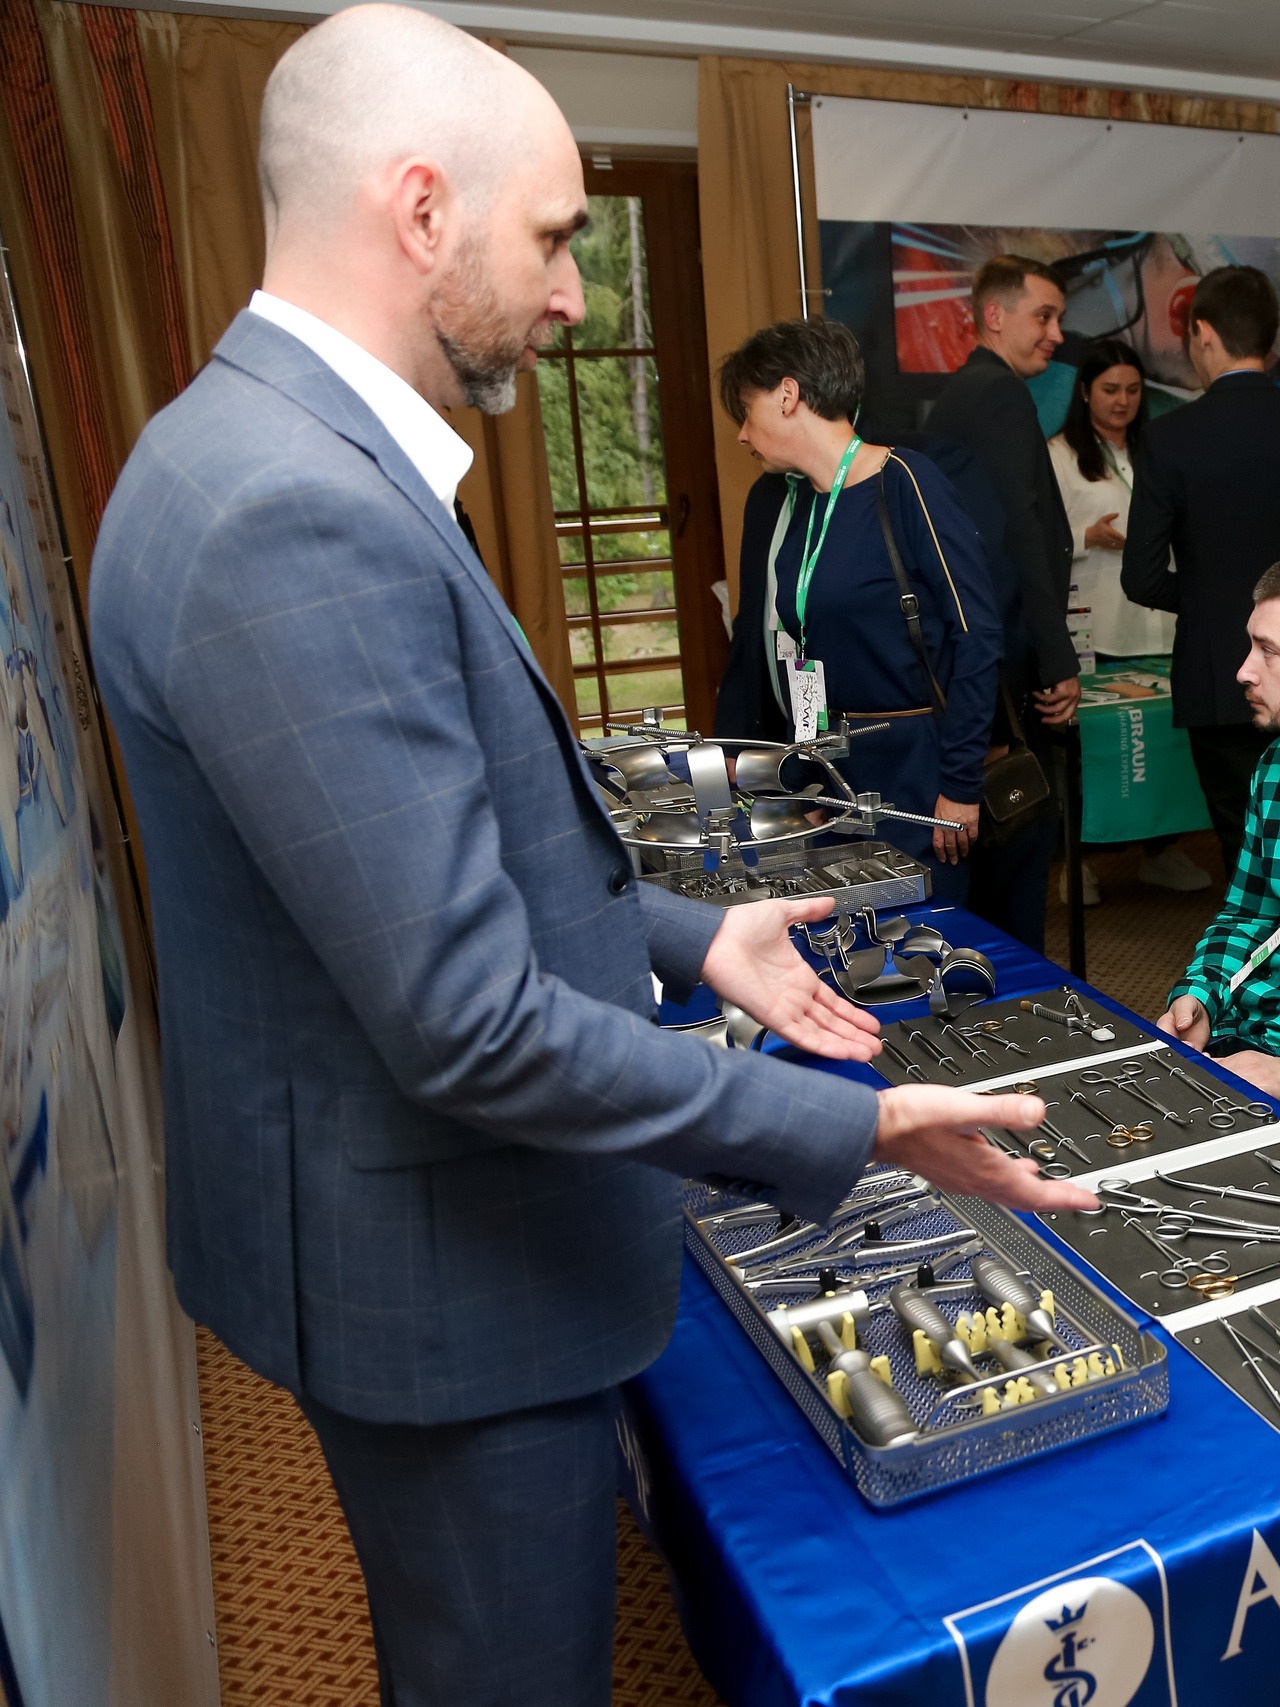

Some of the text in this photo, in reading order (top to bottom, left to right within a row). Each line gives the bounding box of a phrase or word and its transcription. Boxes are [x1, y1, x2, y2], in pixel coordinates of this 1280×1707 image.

[1118, 711, 1128, 750] SHARING
[1129, 709, 1146, 782] BRAUN
[1121, 754, 1129, 799] EXPERTISE
